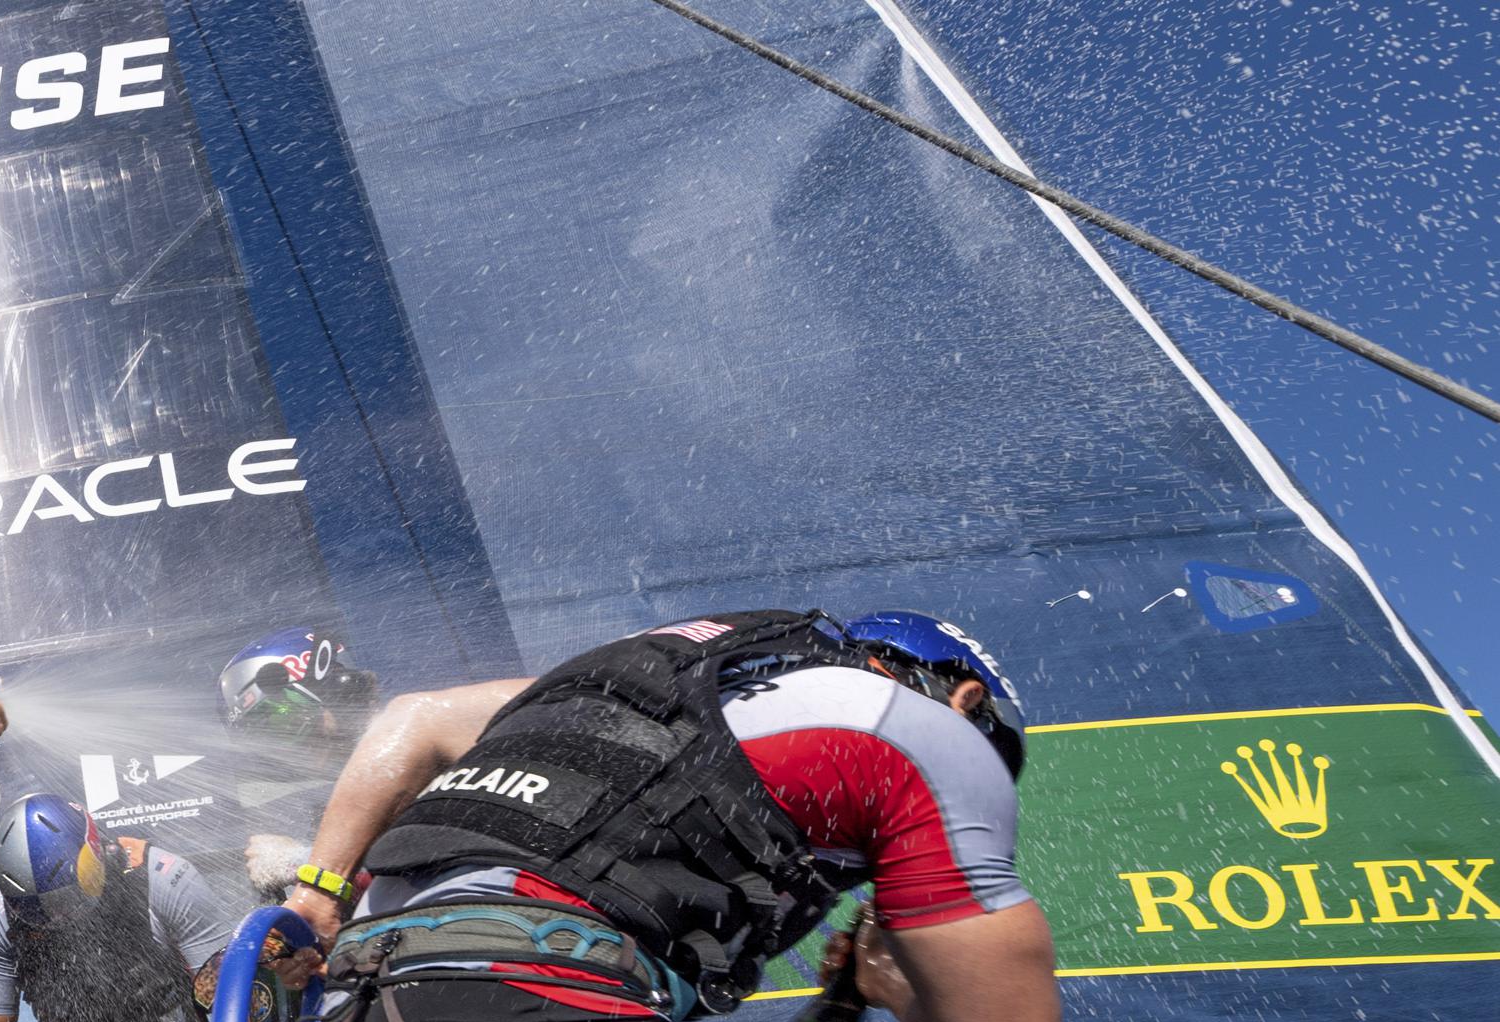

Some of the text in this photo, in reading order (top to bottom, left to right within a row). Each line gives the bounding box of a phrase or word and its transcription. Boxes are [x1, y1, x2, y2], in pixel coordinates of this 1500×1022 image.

[145, 796, 214, 813] NAUTIQUE
[106, 808, 201, 829] SAINT-TROPEZ
[1118, 859, 1500, 932] ROLEX
